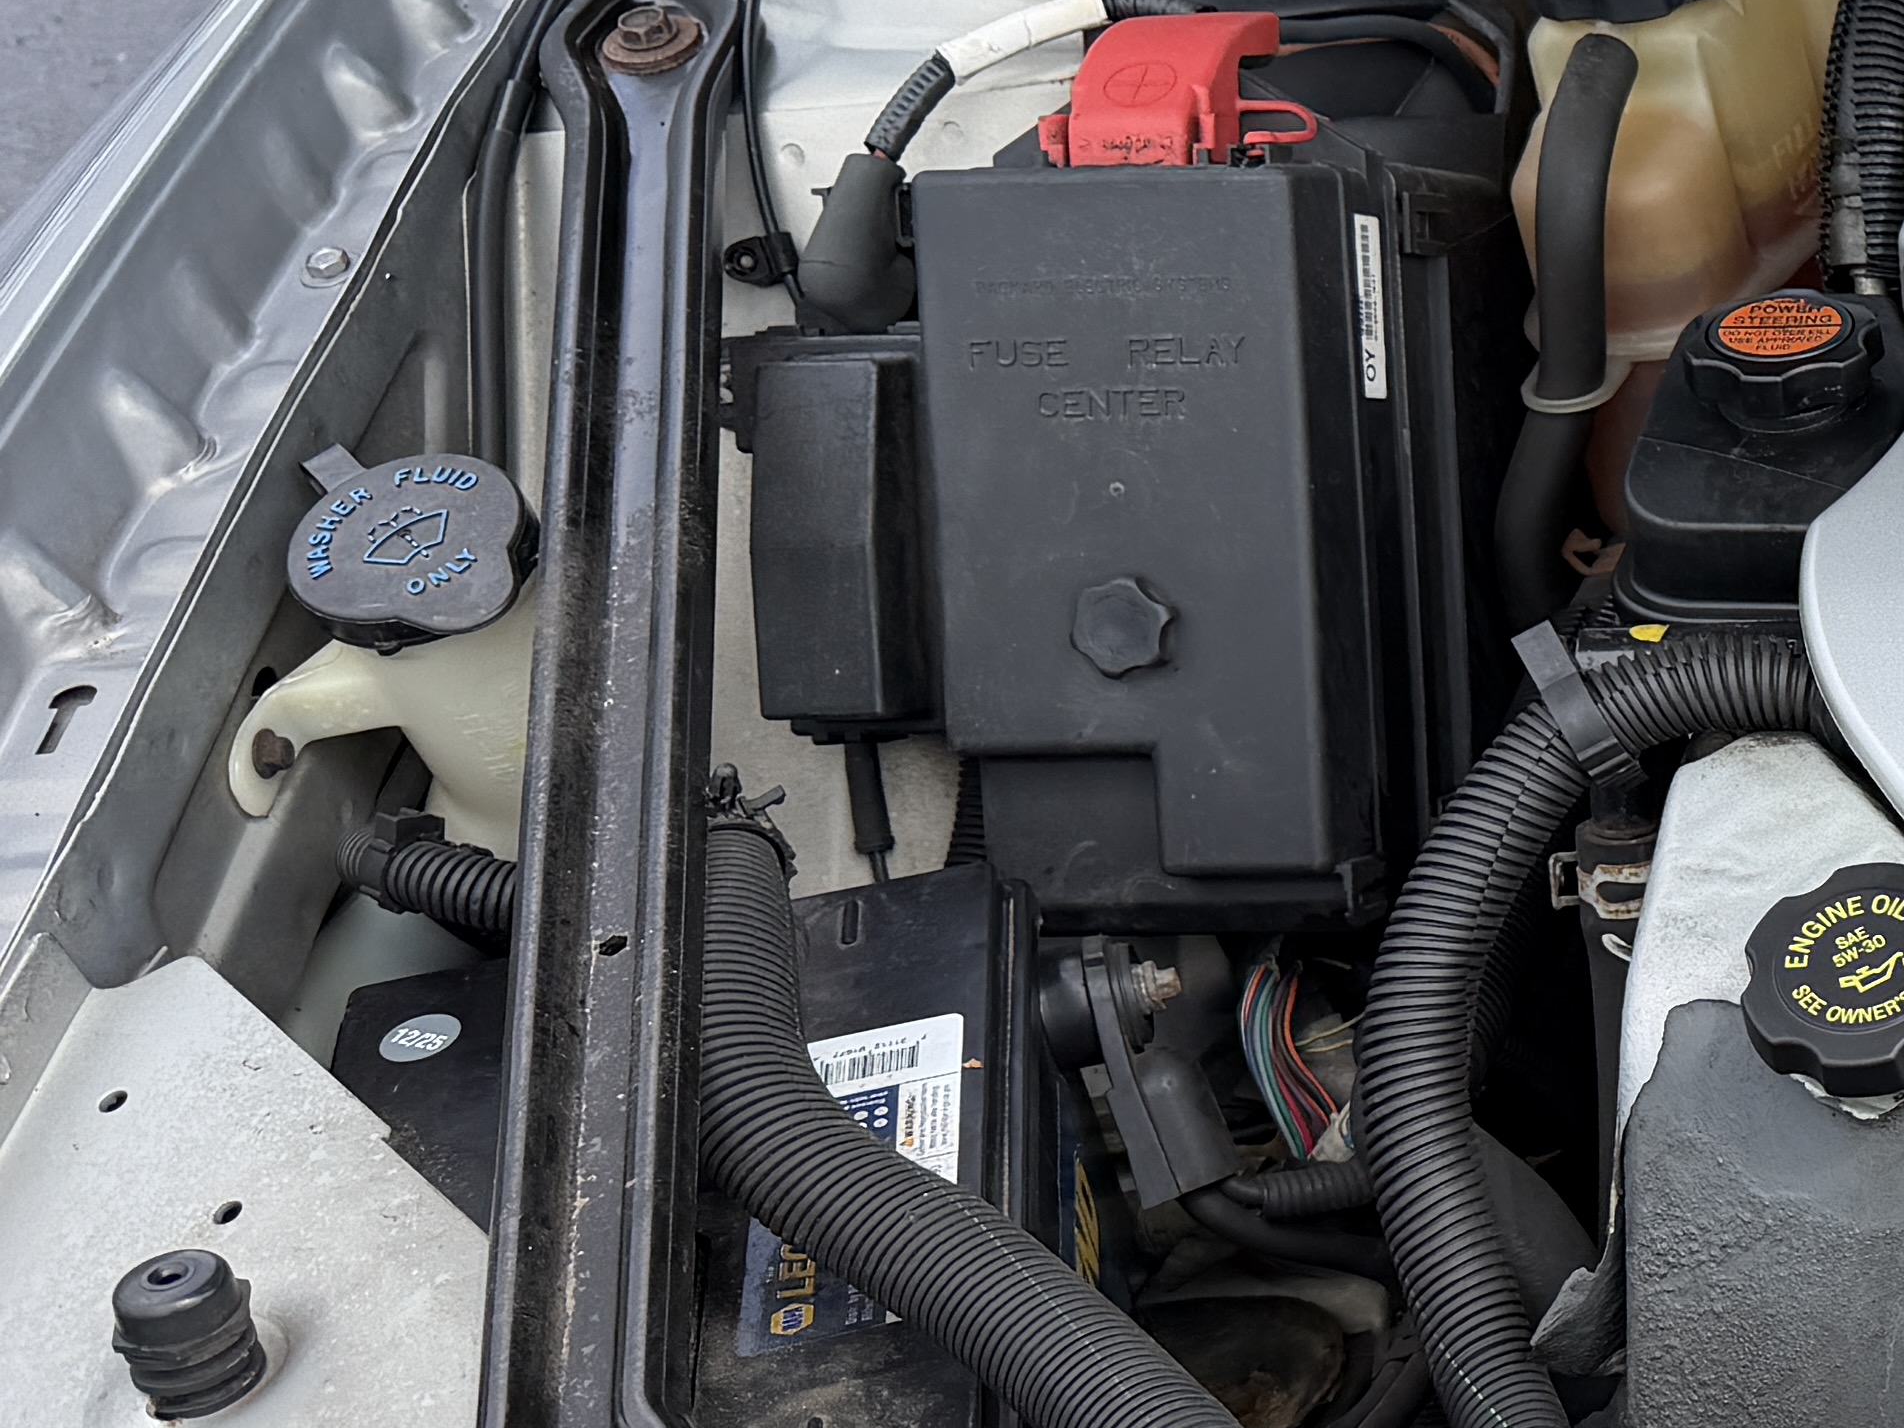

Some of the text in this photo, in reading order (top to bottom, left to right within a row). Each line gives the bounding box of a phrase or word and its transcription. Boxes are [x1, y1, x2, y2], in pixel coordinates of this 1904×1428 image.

[1733, 315, 1832, 325] STEERING
[968, 334, 1246, 370] FUSE RELAY
[1038, 387, 1187, 420] CENTER
[307, 465, 479, 579] WASHER FLUID
[406, 546, 478, 595] ONLY
[1784, 895, 1865, 969] ENGINE
[1834, 926, 1870, 950] SAE
[1832, 934, 1887, 968] 5W-30
[1792, 984, 1828, 1016] SEE
[391, 1028, 448, 1051] 12/25
